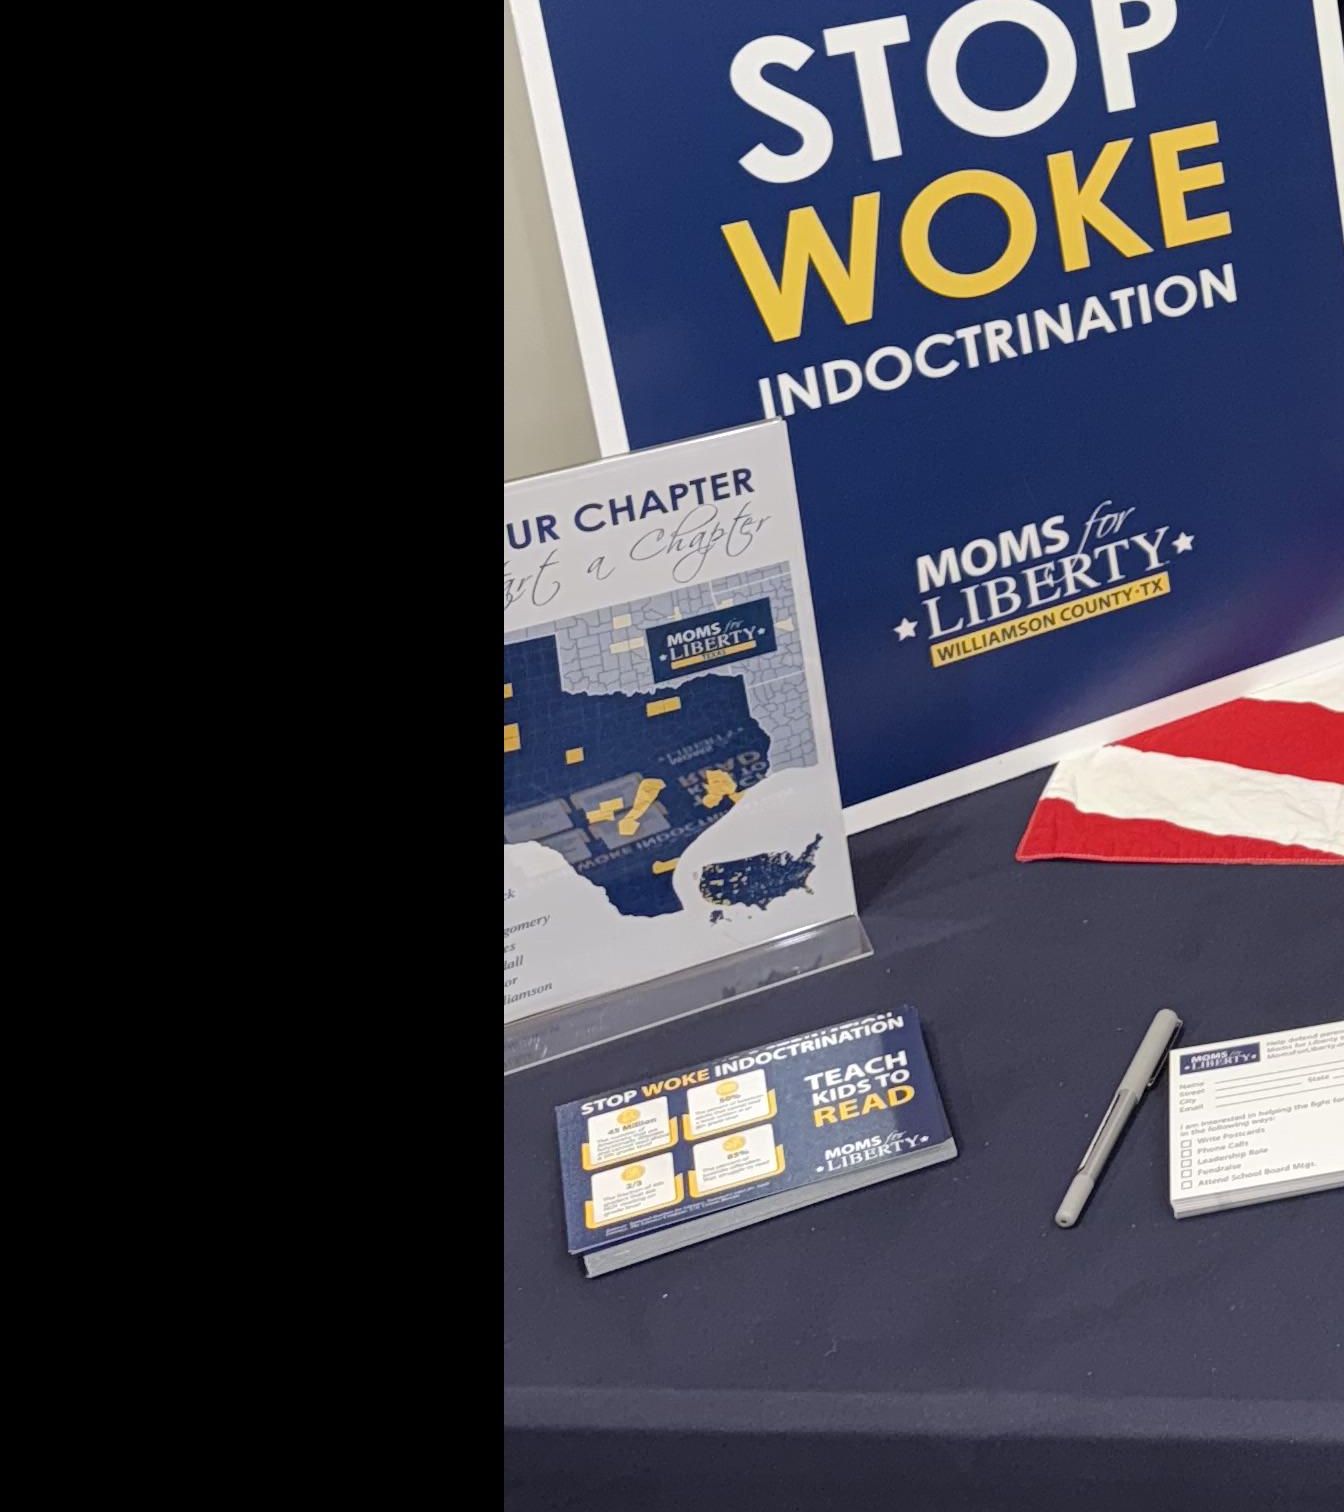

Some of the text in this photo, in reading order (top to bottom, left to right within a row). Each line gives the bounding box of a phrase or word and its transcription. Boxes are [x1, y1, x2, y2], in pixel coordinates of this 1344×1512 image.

[721, 121, 1232, 343] WOKE
[759, 263, 1237, 419] INDOCTRINATION
[506, 468, 755, 550] UR CHAPTER
[587, 556, 616, 580] a
[630, 501, 772, 583] Chapter
[916, 515, 1069, 593] MOMS
[922, 526, 1169, 639] LIBERTY
[667, 622, 721, 647] MOMS
[669, 627, 757, 661] LIBERTY
[938, 613, 1056, 661] WILLIAMSON
[504, 915, 550, 937] gomery
[504, 982, 552, 1005] liamson
[581, 1015, 905, 1117] STOP WOKE INDOCTRINATION
[804, 1050, 908, 1090] TEACH
[1191, 1051, 1228, 1063] MOMS
[1192, 1054, 1251, 1071] LIBERTY
[812, 1068, 910, 1106] KIDS TO
[812, 1085, 916, 1129] READ
[825, 1136, 882, 1161] MOMS
[827, 1133, 921, 1173] LIBERTY
